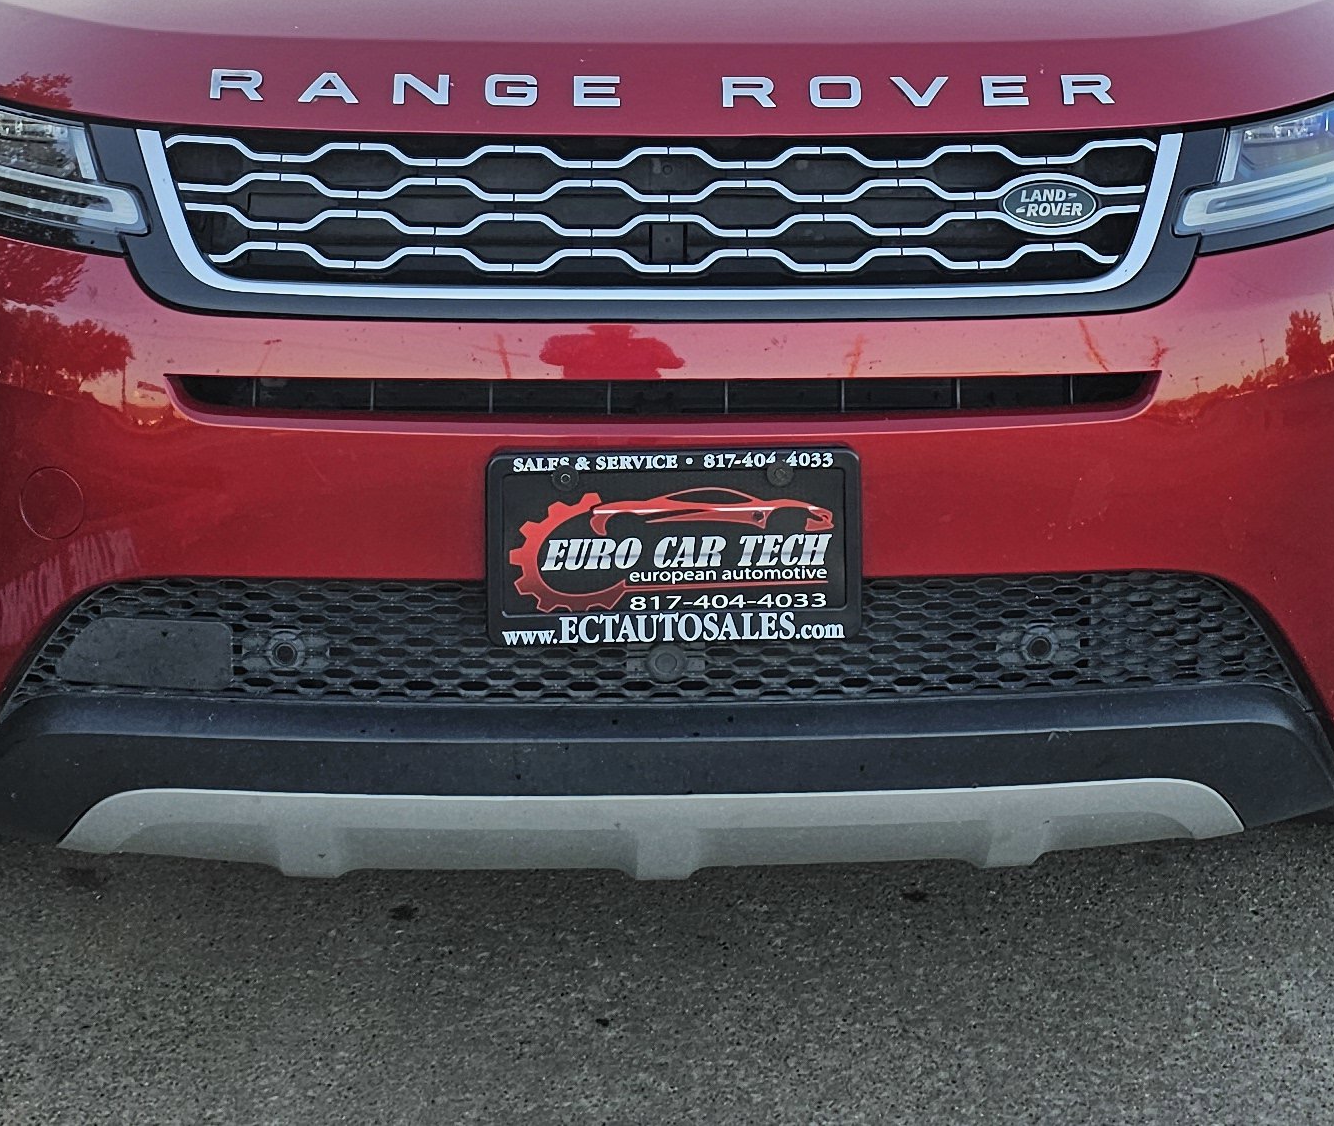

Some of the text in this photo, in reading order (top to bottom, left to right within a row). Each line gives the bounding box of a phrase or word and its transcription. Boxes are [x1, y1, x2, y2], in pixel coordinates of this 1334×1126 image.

[208, 67, 1116, 108] RANGE ROVER
[1020, 188, 1067, 203] LAND
[1025, 202, 1083, 217] ROVER
[574, 456, 591, 471] &
[595, 454, 678, 471] SERVICE
[540, 533, 833, 572] EURO CAR TECH
[629, 566, 828, 584] european automotive
[629, 592, 827, 611] 817-404-4033
[502, 611, 846, 645] www.ECTAUTOSALES.com
